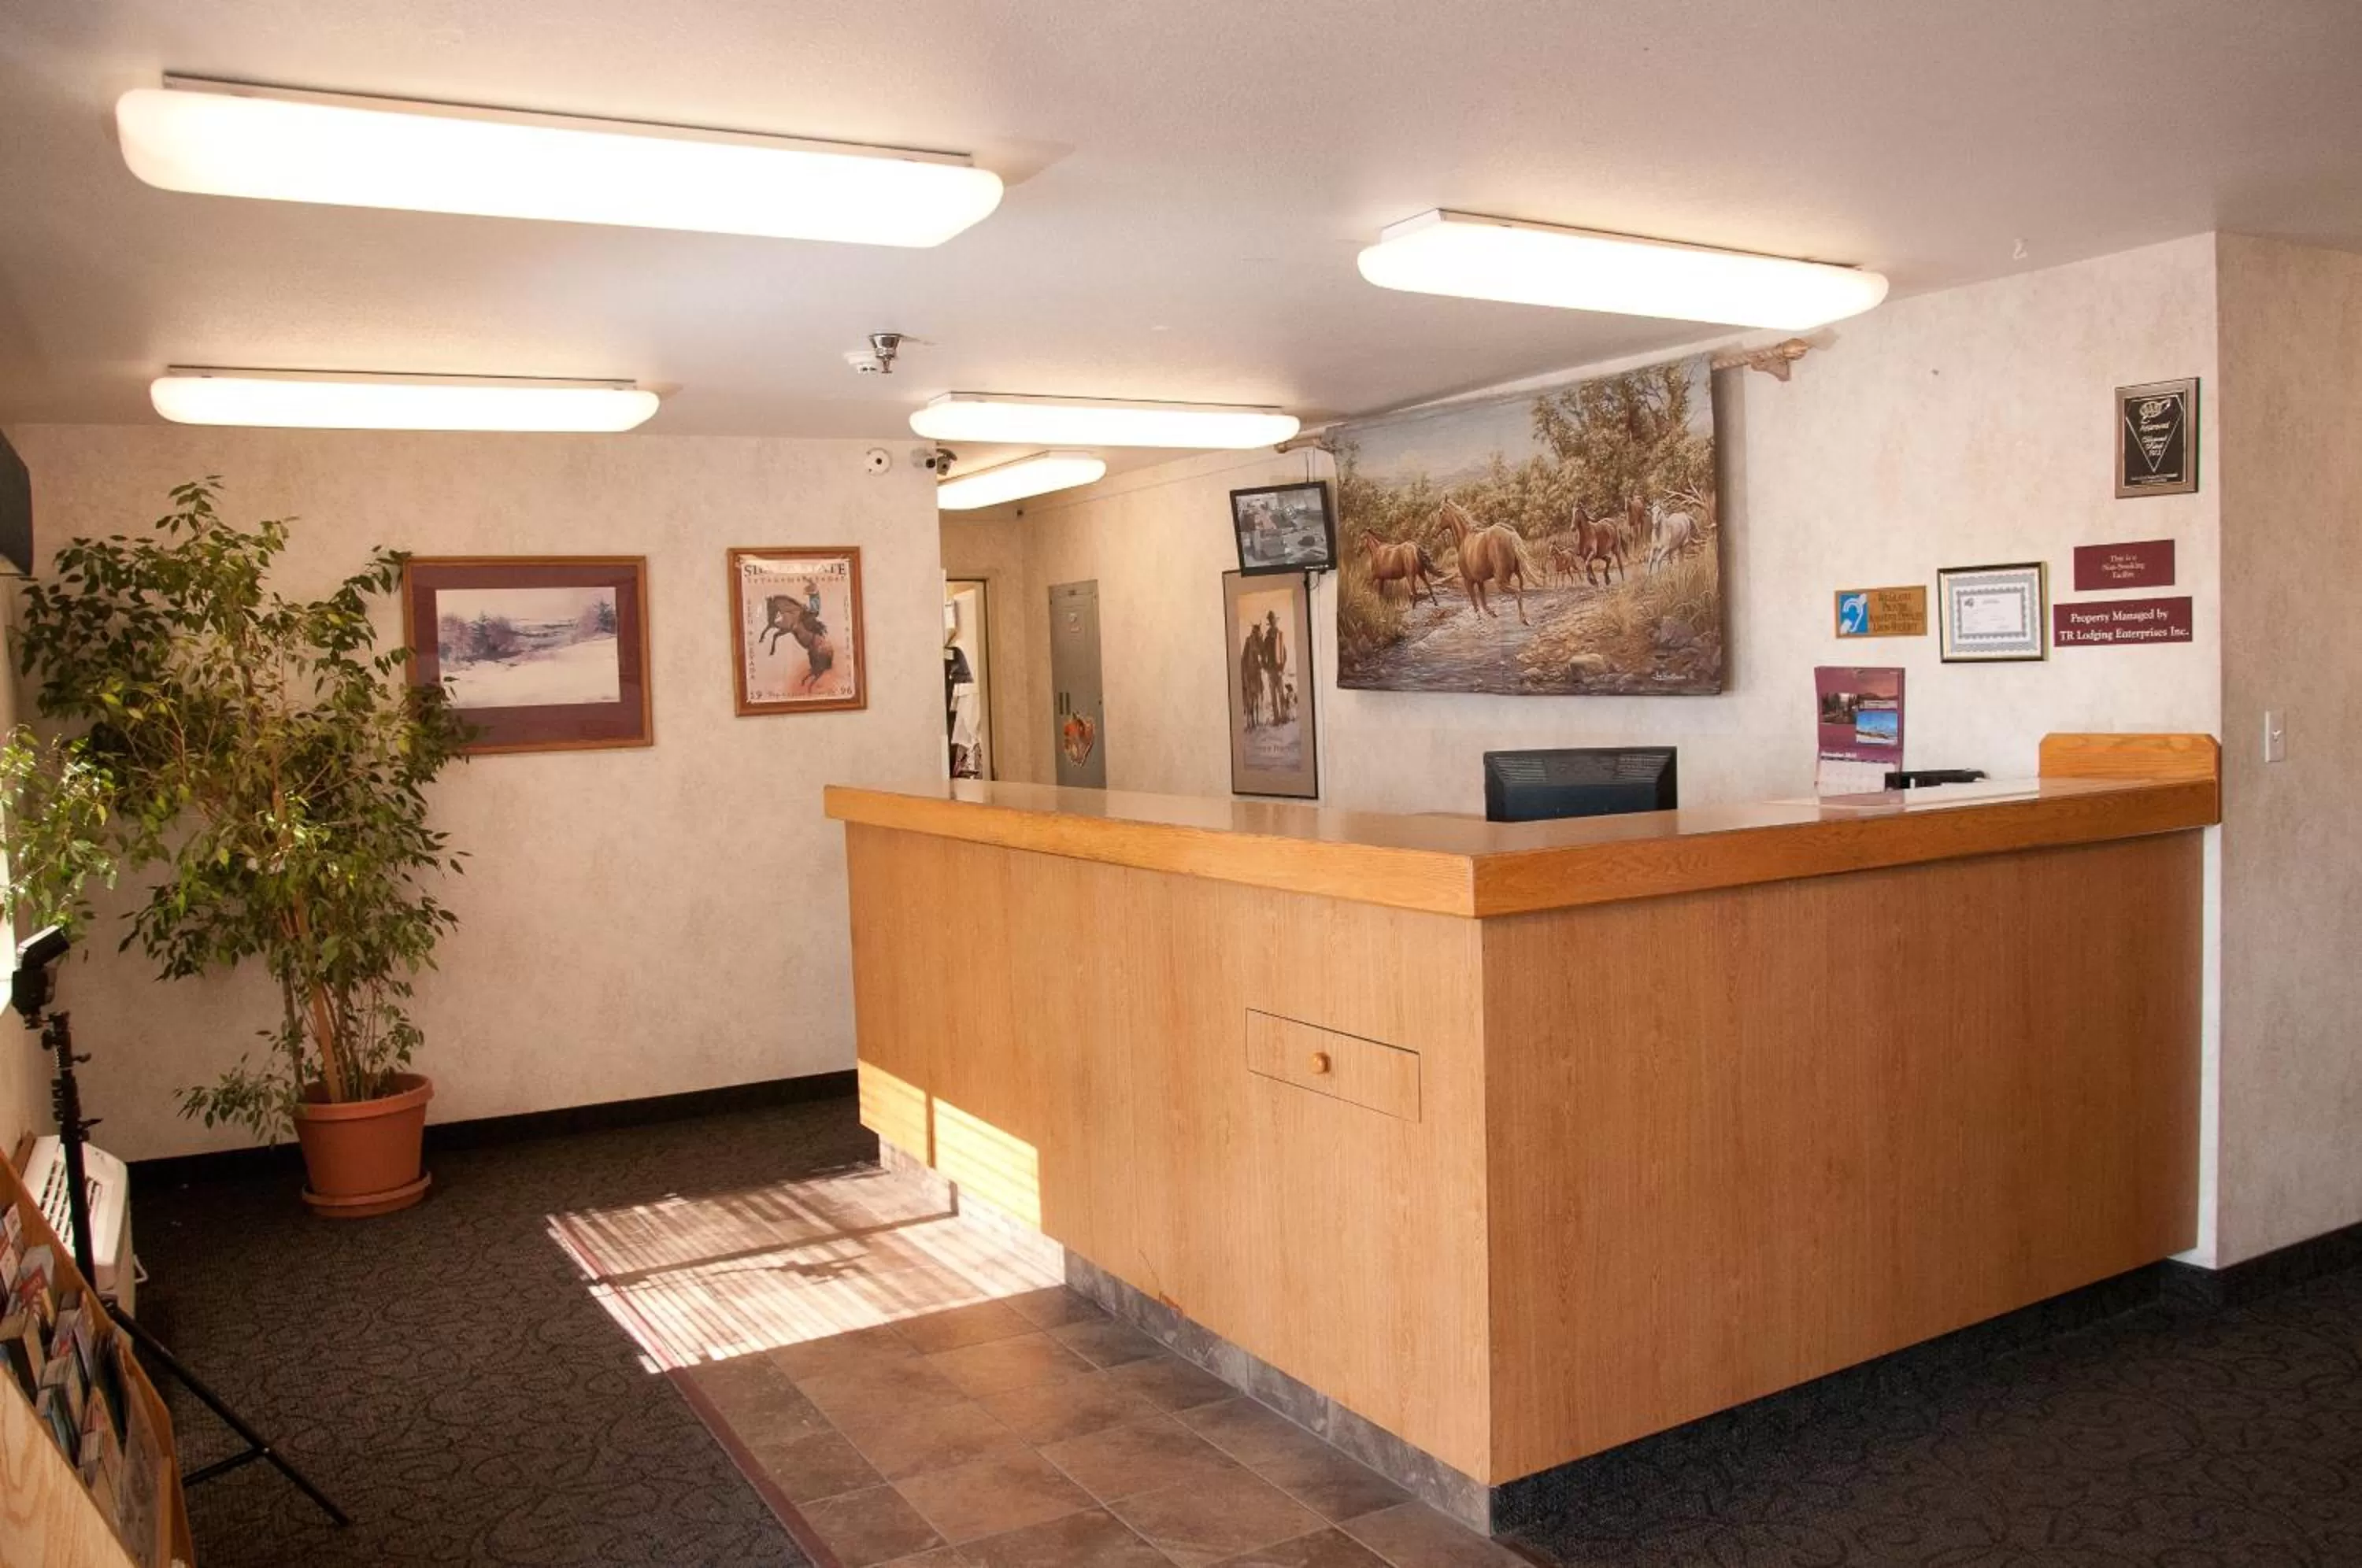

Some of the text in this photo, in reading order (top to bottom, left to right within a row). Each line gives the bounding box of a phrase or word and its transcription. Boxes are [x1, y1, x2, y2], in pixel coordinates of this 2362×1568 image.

[2070, 608, 2168, 624] Property Managed by
[2059, 626, 2190, 642] TR Lodging Enterprises Inc.
